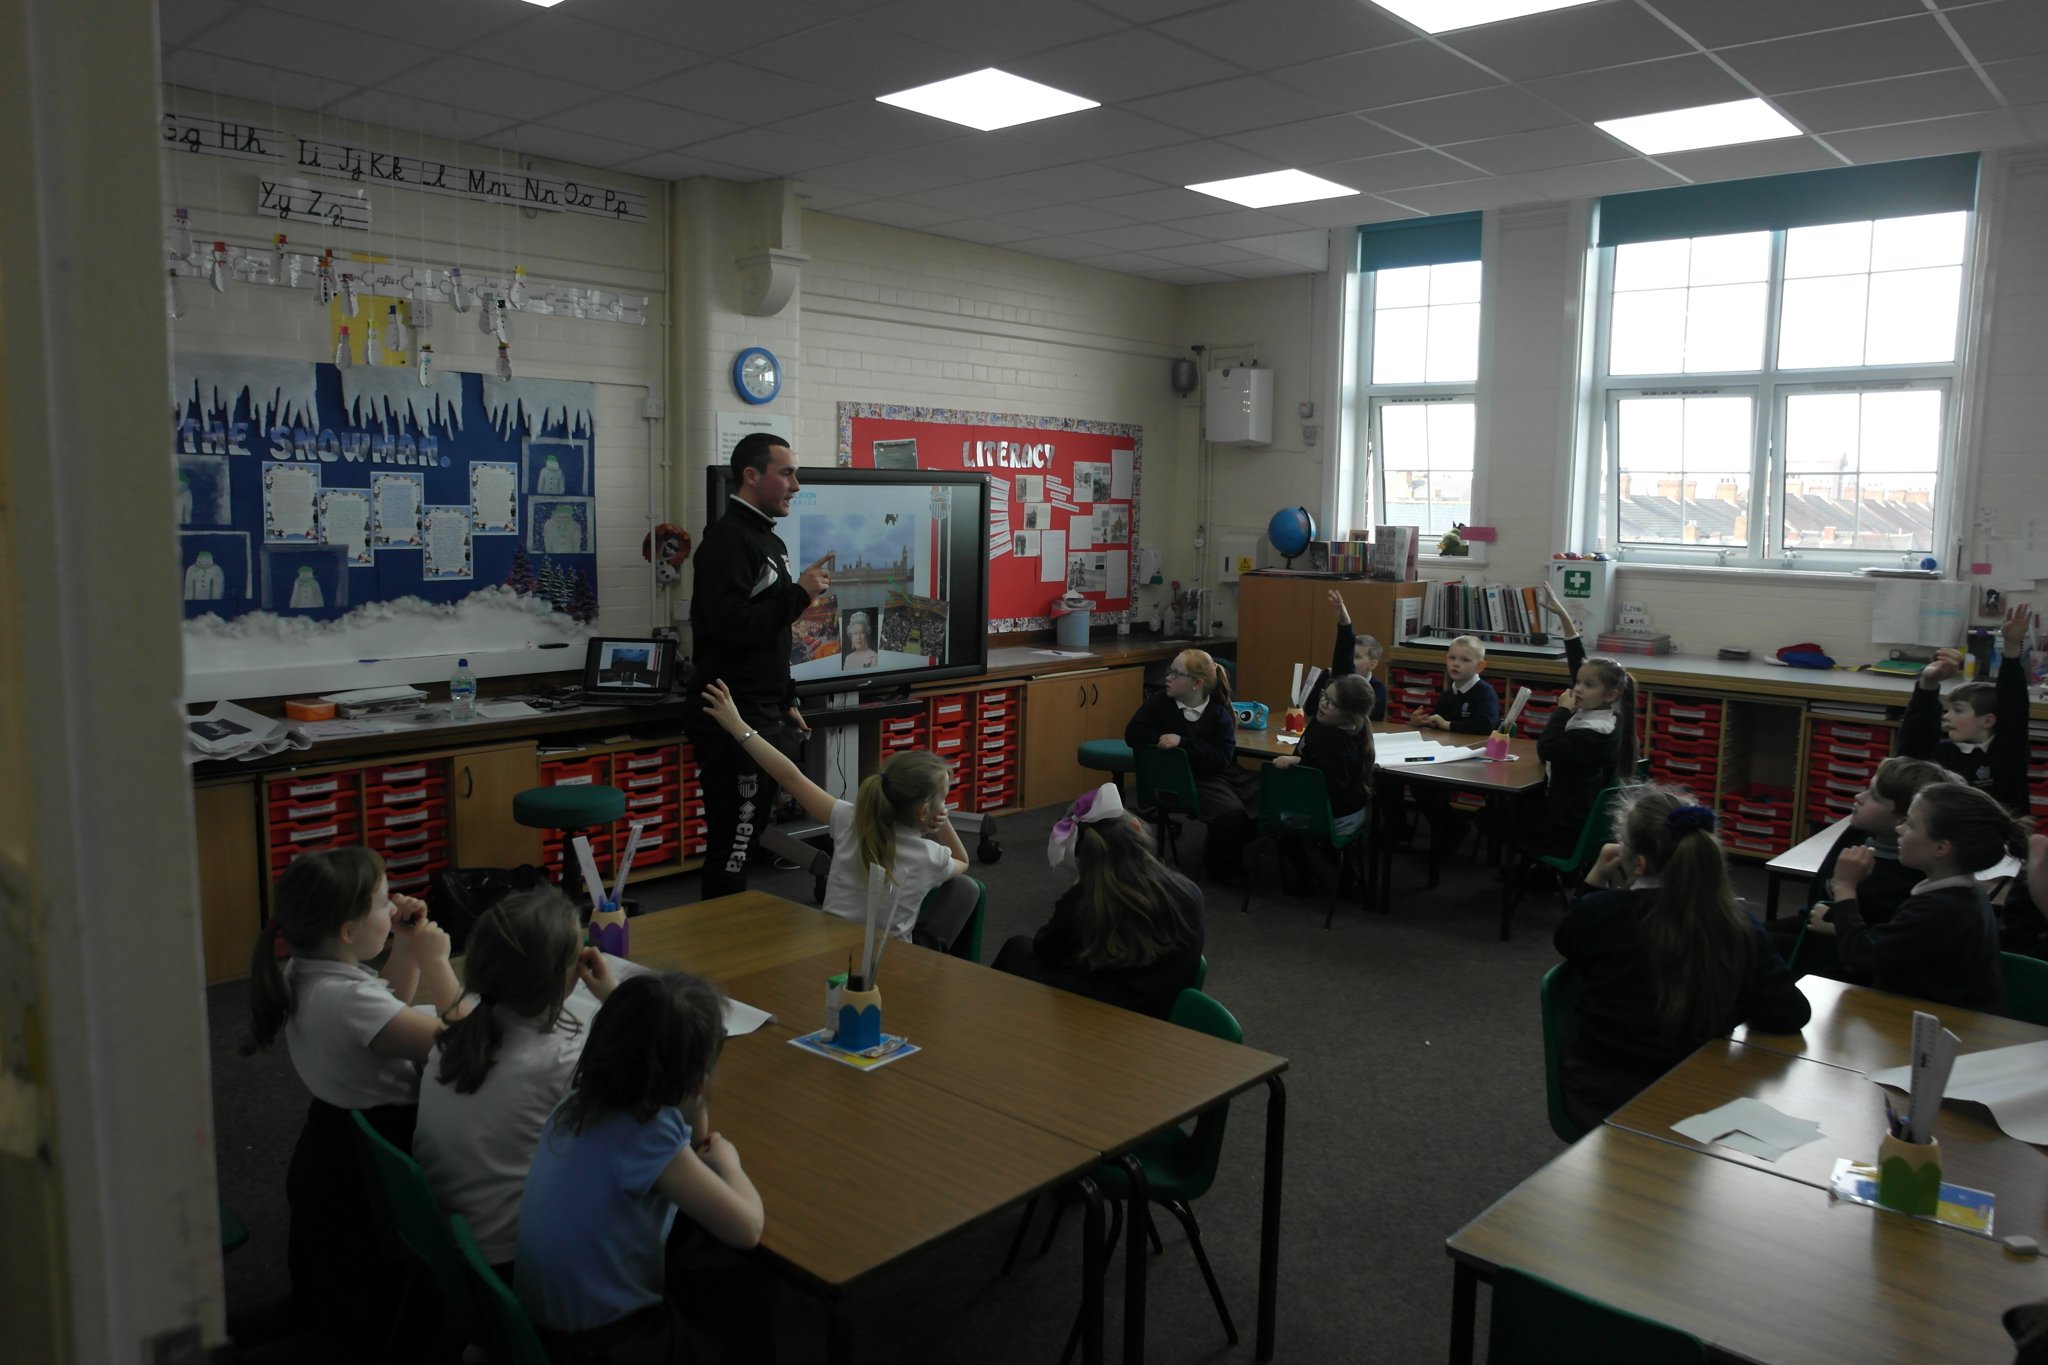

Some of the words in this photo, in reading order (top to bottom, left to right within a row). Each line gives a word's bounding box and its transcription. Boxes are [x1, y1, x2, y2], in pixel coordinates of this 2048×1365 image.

[220, 122, 266, 154] Hh
[184, 418, 252, 456] THE
[962, 441, 1056, 469] LITERACY
[1564, 588, 1579, 596] First
